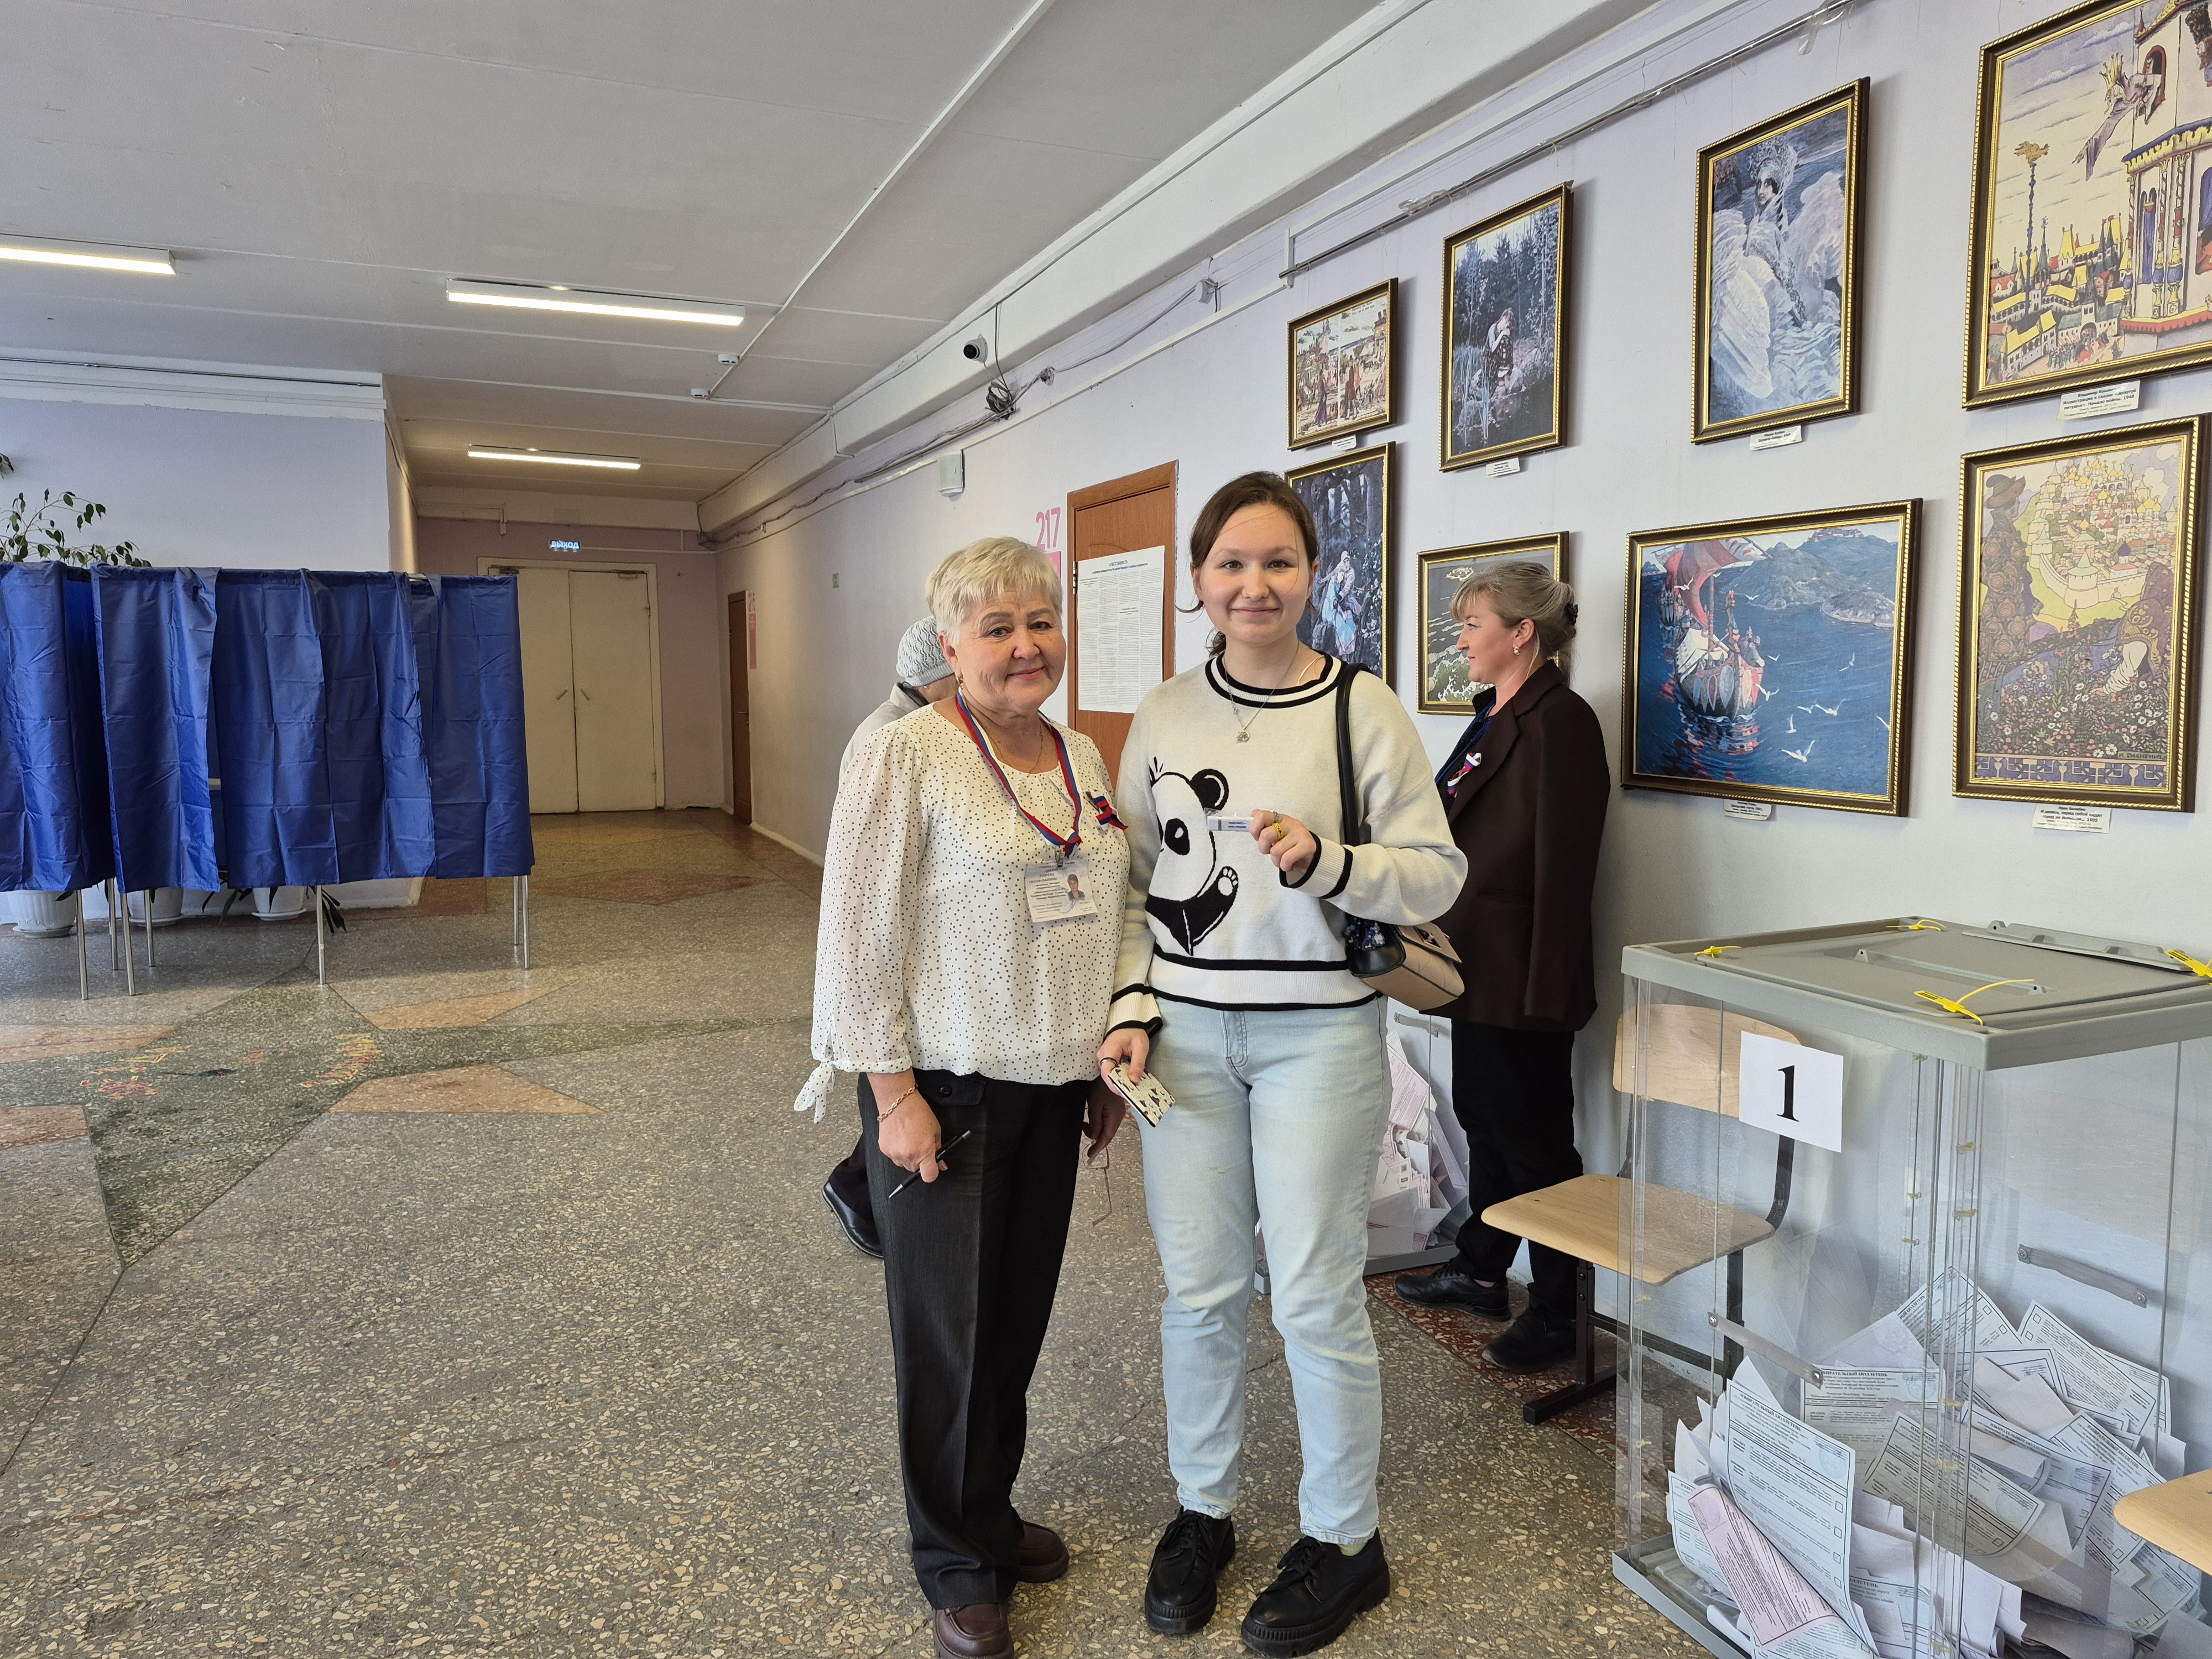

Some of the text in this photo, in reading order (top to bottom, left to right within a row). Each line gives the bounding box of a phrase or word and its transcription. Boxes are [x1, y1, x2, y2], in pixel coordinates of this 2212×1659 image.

[551, 541, 579, 549] ВЫХОД
[1036, 507, 1061, 550] 217
[1777, 1065, 1800, 1123] 1
